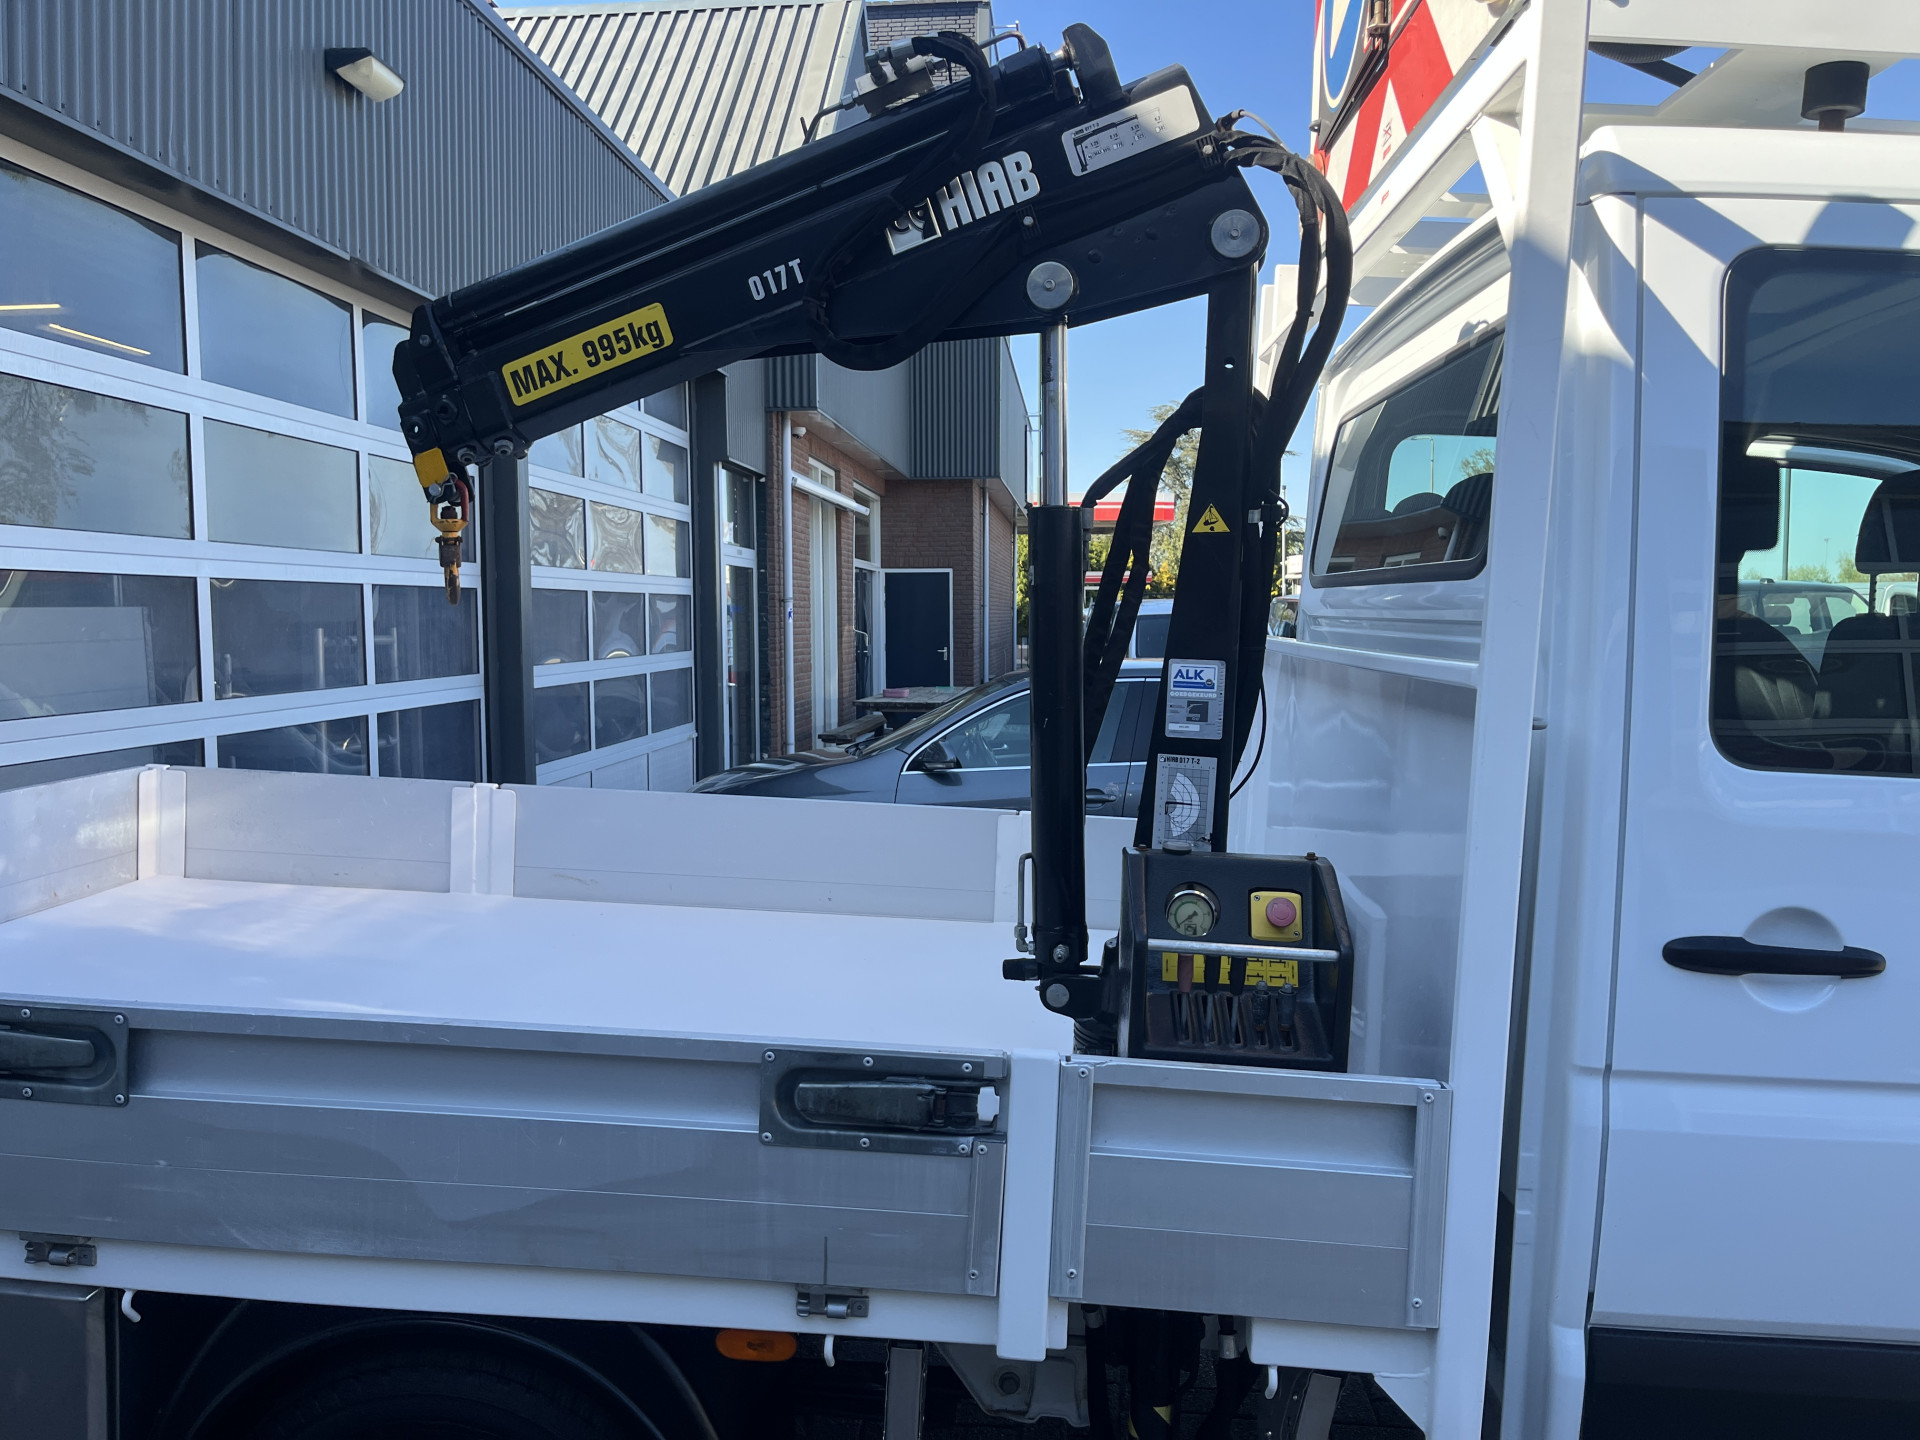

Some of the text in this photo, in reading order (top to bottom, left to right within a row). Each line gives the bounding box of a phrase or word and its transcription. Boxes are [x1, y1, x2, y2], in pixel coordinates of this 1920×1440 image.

[935, 150, 1041, 231] HIAB
[748, 258, 805, 301] 017T
[509, 319, 666, 398] MAX. 995kg
[1173, 669, 1205, 681] ALK
